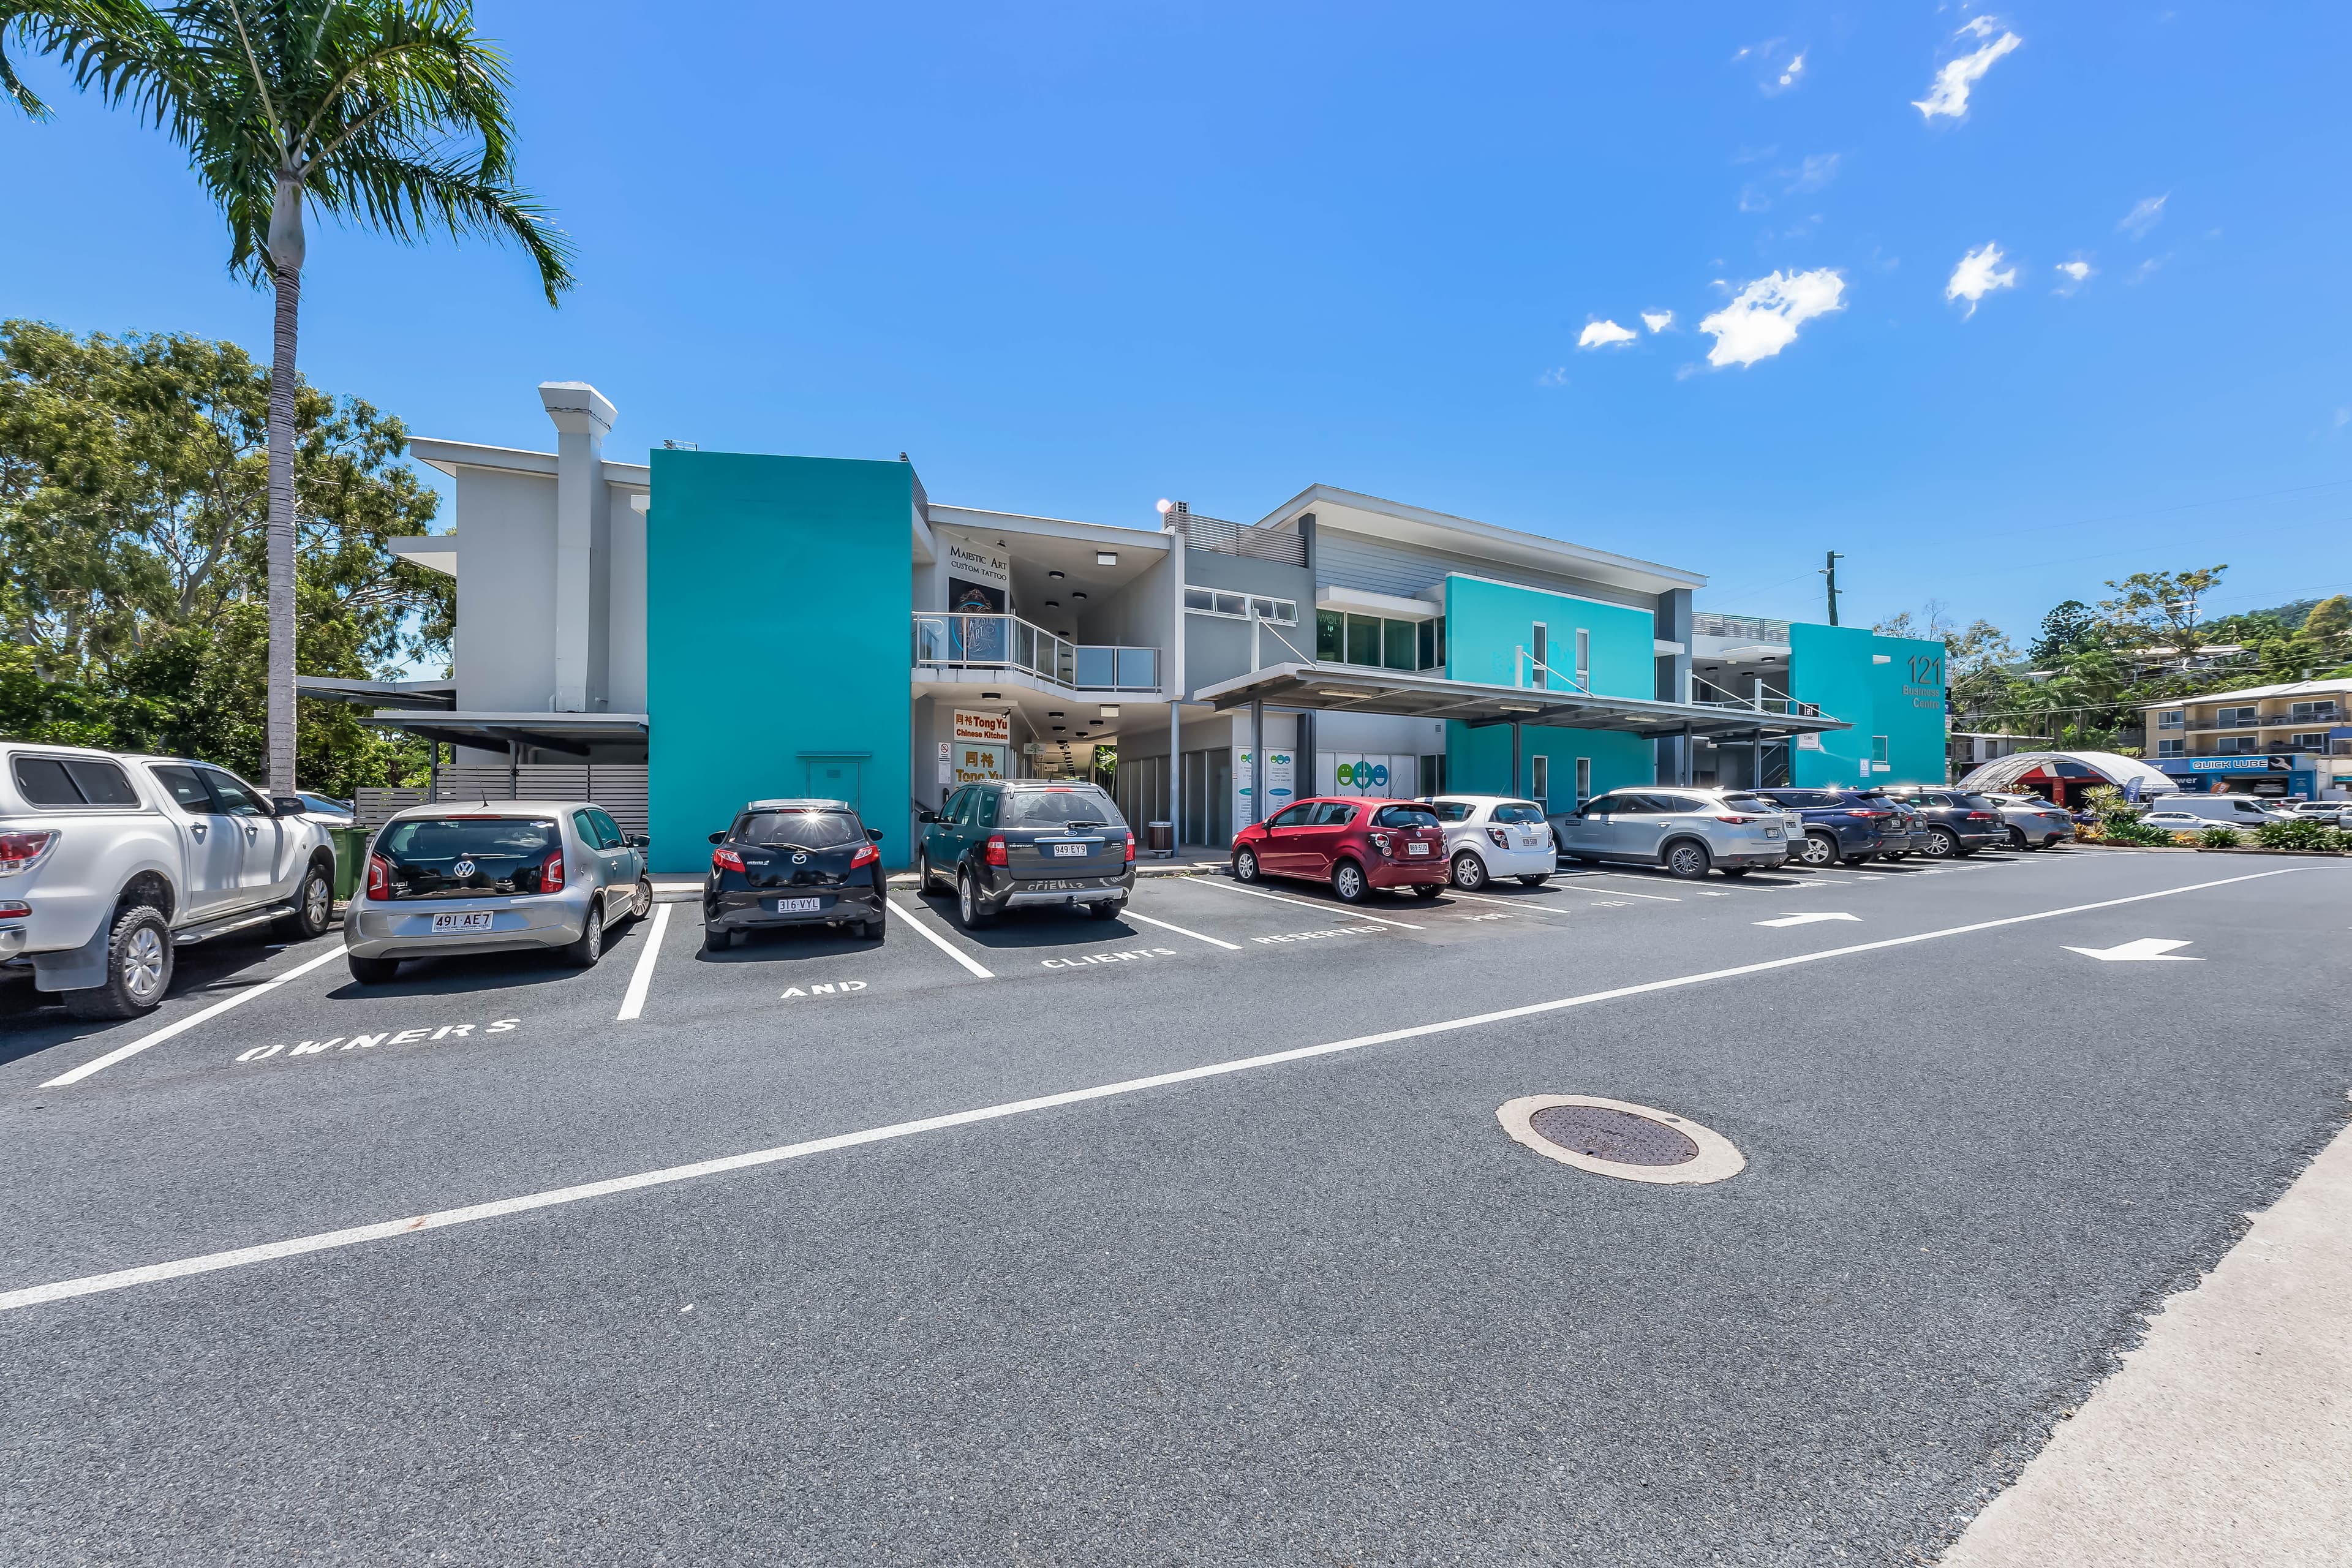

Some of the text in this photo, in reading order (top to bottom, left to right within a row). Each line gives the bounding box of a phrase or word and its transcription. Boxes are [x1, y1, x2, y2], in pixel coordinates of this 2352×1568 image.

[950, 545, 1007, 570] MAJESTIC ART
[951, 561, 1007, 581] CUSTOM TATTOO
[1908, 655, 1940, 685] 121
[1902, 685, 1939, 696] Business
[1913, 697, 1940, 709] Centre
[973, 716, 1008, 731] Tong Yu
[956, 729, 1008, 740] Chinese Kitchen
[2193, 760, 2268, 769] QUICK LUBE
[1461, 913, 1514, 922] FOR
[1250, 925, 1389, 944] RESERVED
[1041, 948, 1177, 968] CLIENTS
[780, 981, 868, 999] AND
[235, 1019, 521, 1061] OWNERS
